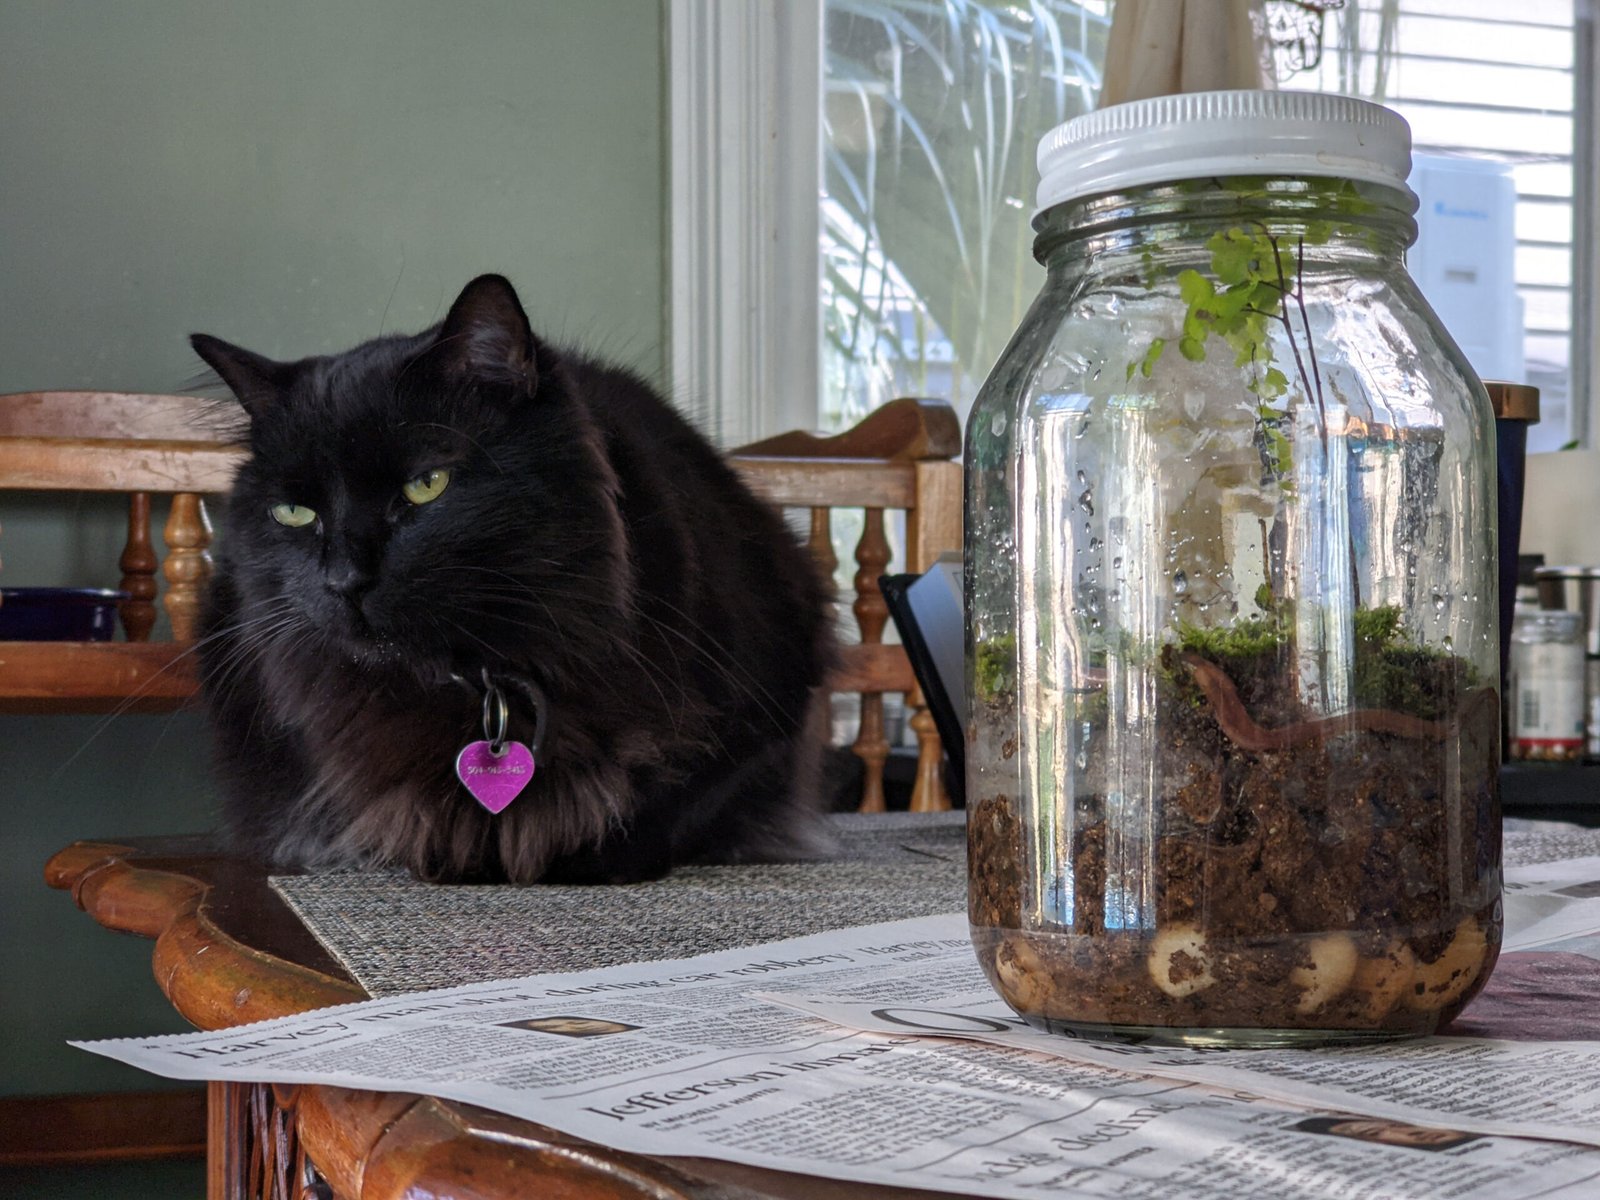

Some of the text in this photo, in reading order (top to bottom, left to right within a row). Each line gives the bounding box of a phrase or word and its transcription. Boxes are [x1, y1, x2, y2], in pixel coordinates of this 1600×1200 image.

[856, 938, 972, 956] Harvey ma
[171, 1021, 349, 1059] Harvey
[354, 1004, 456, 1023] man
[456, 993, 545, 1007] shot
[545, 981, 676, 998] during
[669, 972, 727, 984] car
[724, 953, 856, 976] robbery
[582, 1071, 788, 1122] Jefferson
[769, 1037, 922, 1072] inmate
